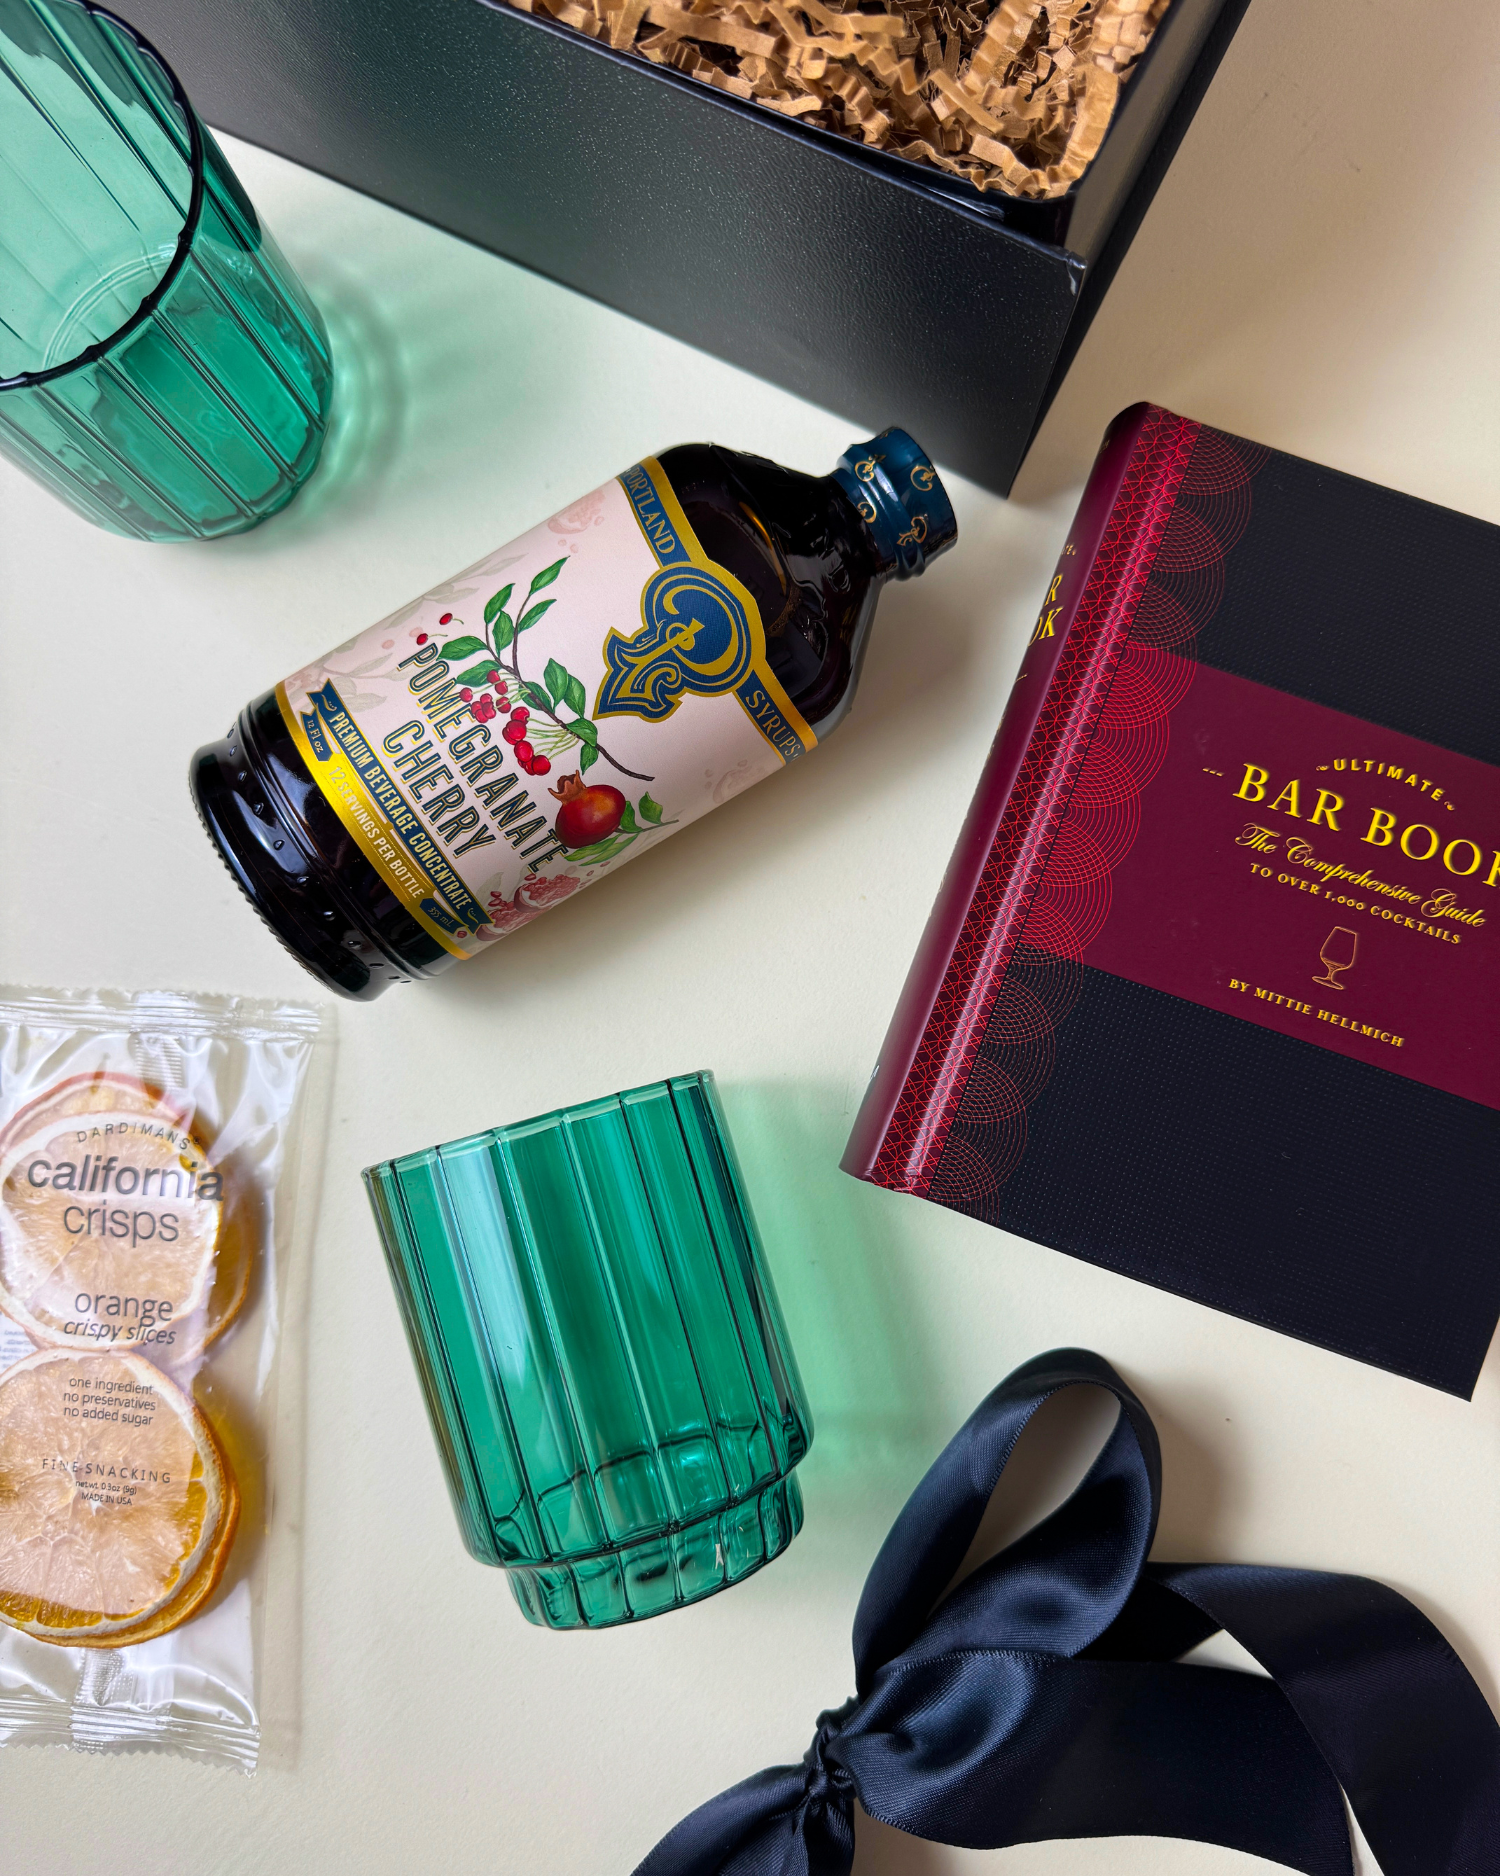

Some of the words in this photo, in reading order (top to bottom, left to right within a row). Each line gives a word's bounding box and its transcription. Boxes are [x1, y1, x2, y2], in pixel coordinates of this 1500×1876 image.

[630, 465, 676, 555] PORTLAND
[745, 690, 800, 758] SYRUPS
[397, 642, 570, 875] POMEGRANATE
[1333, 758, 1446, 801] ULTIMATE
[329, 711, 370, 769] PREMIUM
[364, 766, 416, 835] BEVERAGE
[409, 832, 473, 910] CONCENTRATE
[381, 720, 497, 859] CHERRY
[1233, 763, 1345, 832] BAR
[328, 766, 345, 784] 12
[337, 782, 380, 840] SERVINGS
[374, 837, 395, 862] PER
[389, 858, 424, 899] BOTTLE
[1235, 822, 1281, 854] The
[1285, 836, 1422, 904] Comprehensive
[1420, 888, 1487, 927] Guide
[1250, 862, 1273, 878] TO
[1277, 872, 1320, 896] OVER
[1324, 890, 1365, 911] 1,000
[1370, 905, 1461, 945] COCKTAILS
[1228, 978, 1251, 993] BY
[1254, 987, 1314, 1015] MITTIE
[1317, 1009, 1406, 1048] HELLMICH
[77, 1122, 190, 1150] DARDIMANS
[27, 1154, 225, 1202] california
[63, 1199, 180, 1248] crisps
[63, 1318, 123, 1342] crispy
[126, 1325, 177, 1345] slices
[74, 1292, 174, 1328] orange
[63, 1392, 79, 1403] no
[82, 1394, 156, 1411] preservatives
[69, 1378, 92, 1389] one
[94, 1377, 153, 1394] ingredient
[63, 1407, 80, 1417] no
[82, 1406, 119, 1421] added
[121, 1412, 153, 1427] sugar
[85, 1463, 171, 1484] SNACKING
[81, 1492, 104, 1502] MADE
[116, 1496, 133, 1506] USA
